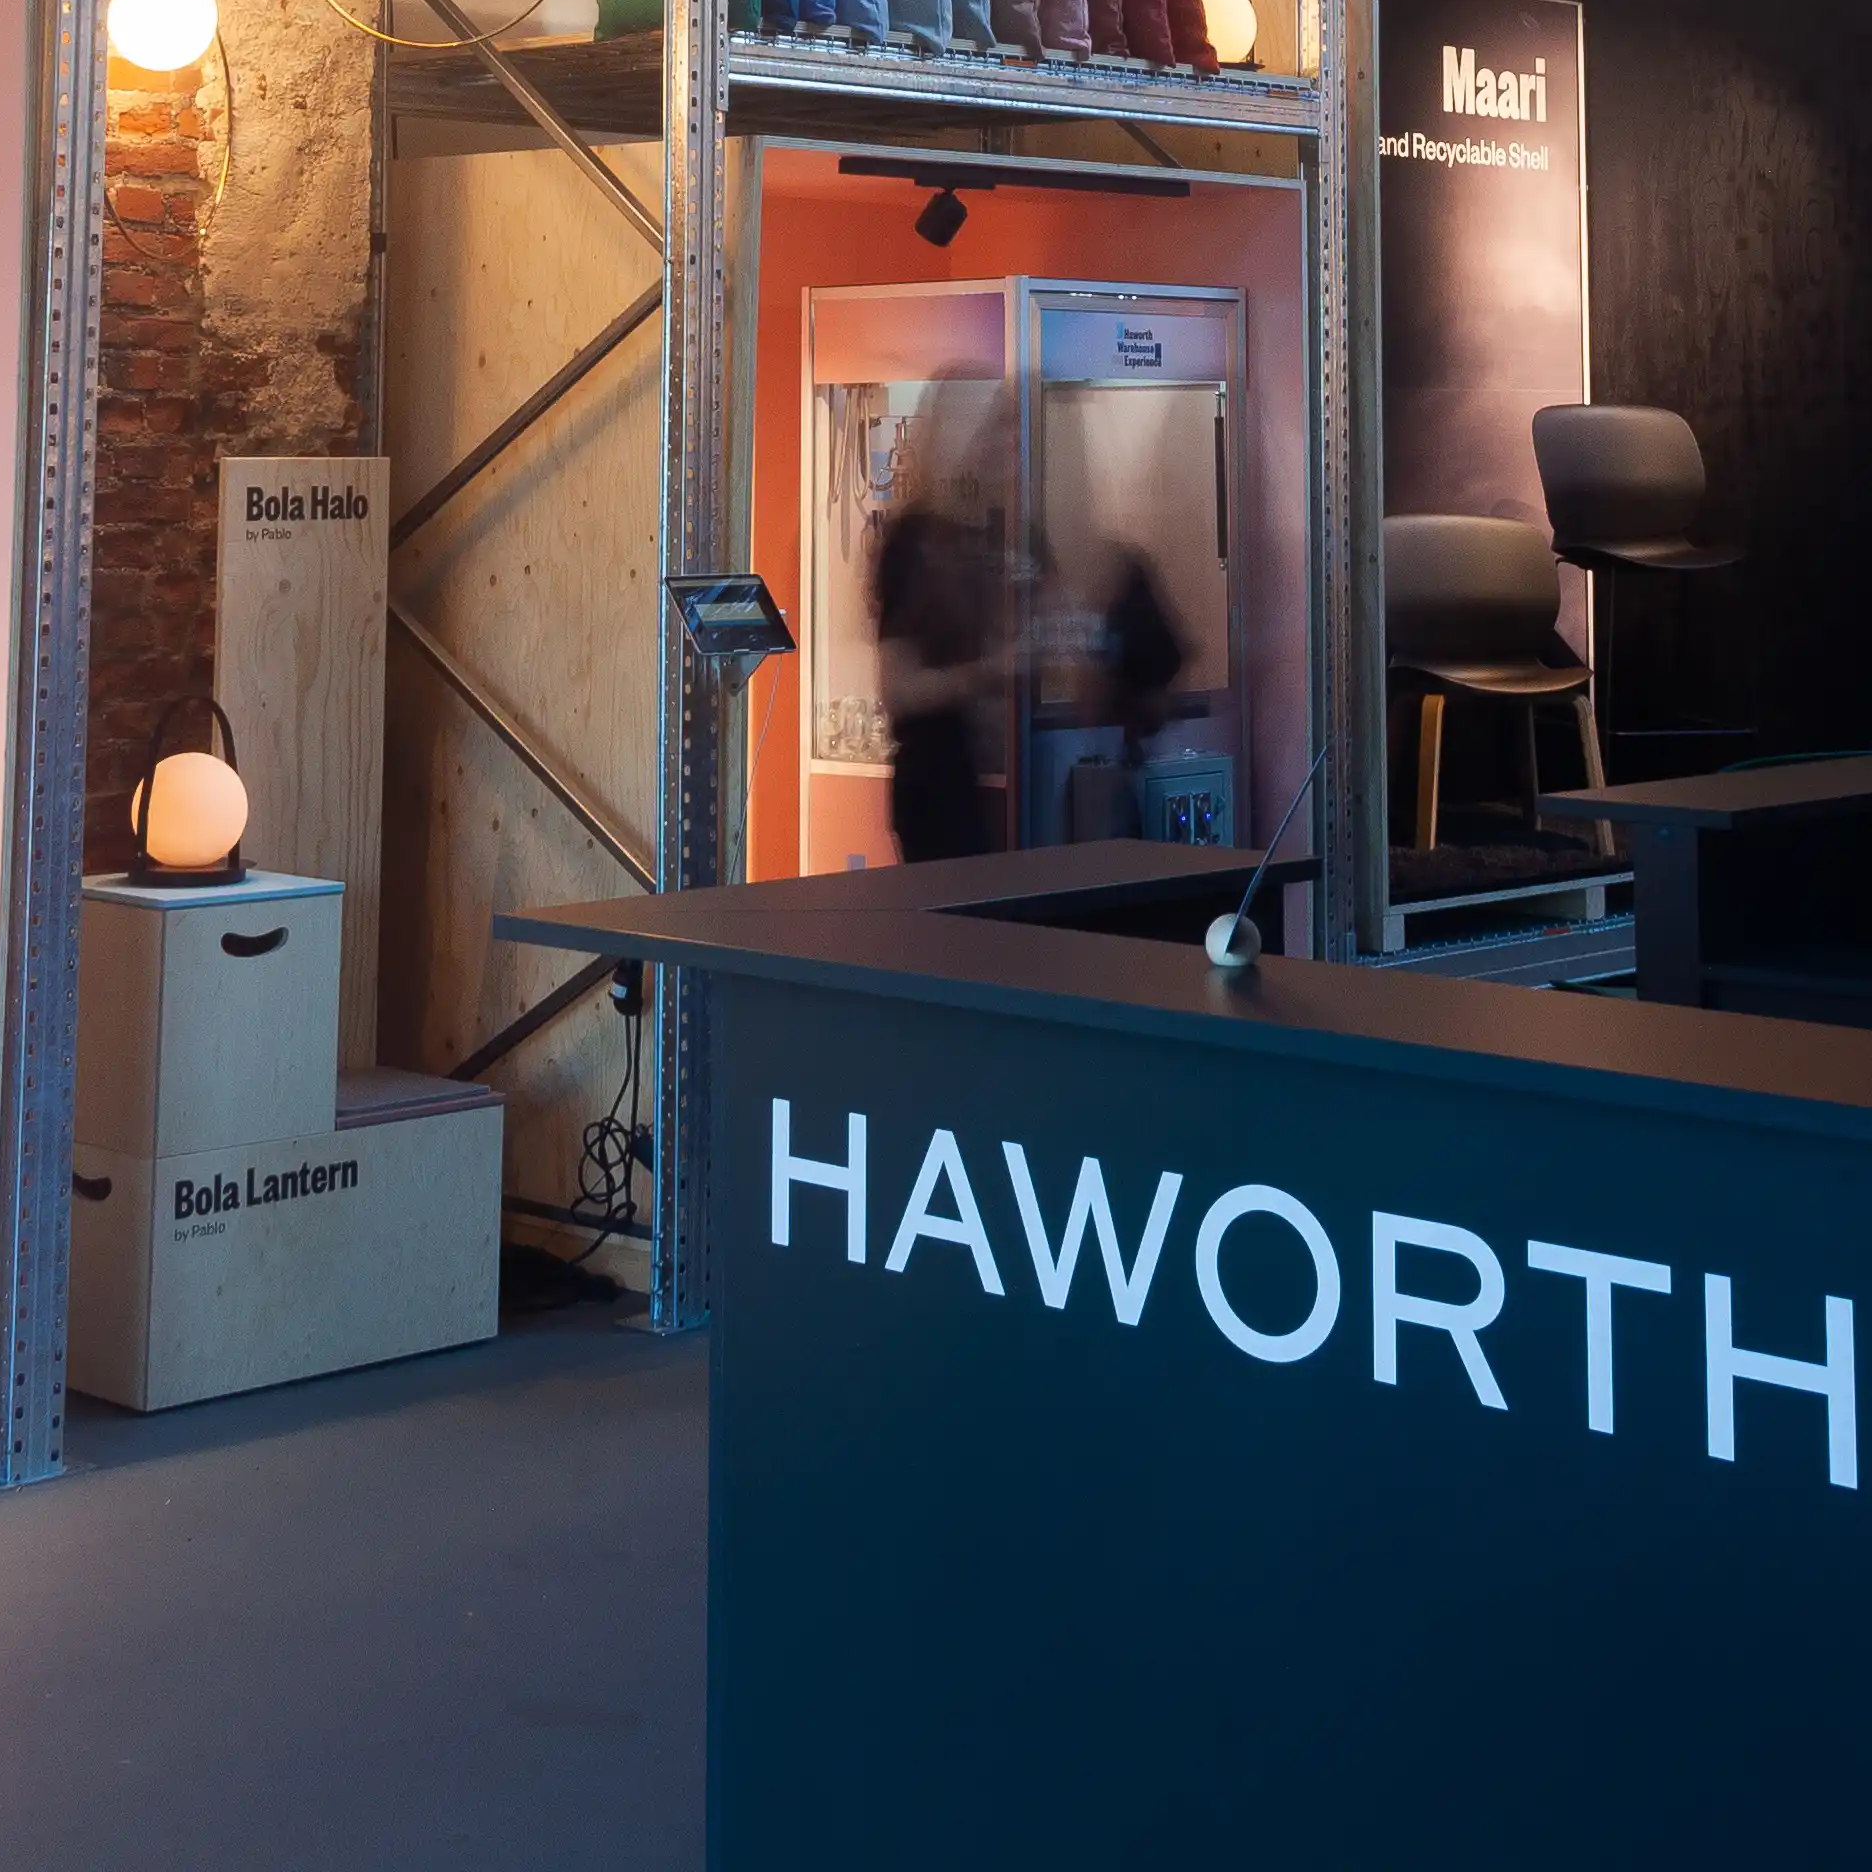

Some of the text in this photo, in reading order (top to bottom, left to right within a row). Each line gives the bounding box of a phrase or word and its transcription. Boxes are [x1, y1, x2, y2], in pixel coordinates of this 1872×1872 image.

[1443, 45, 1547, 123] Maari
[1378, 131, 1549, 171] and Recyclable Shell
[1117, 341, 1155, 353] Warehouse
[1124, 328, 1153, 340] Haworth
[1124, 355, 1162, 369] Experience
[246, 485, 368, 521] Bola Halo
[246, 528, 292, 542] by Pablo
[174, 1159, 358, 1220] Bola Lantern
[174, 1221, 226, 1243] by Pablo
[771, 1097, 1858, 1489] HAWORTH
